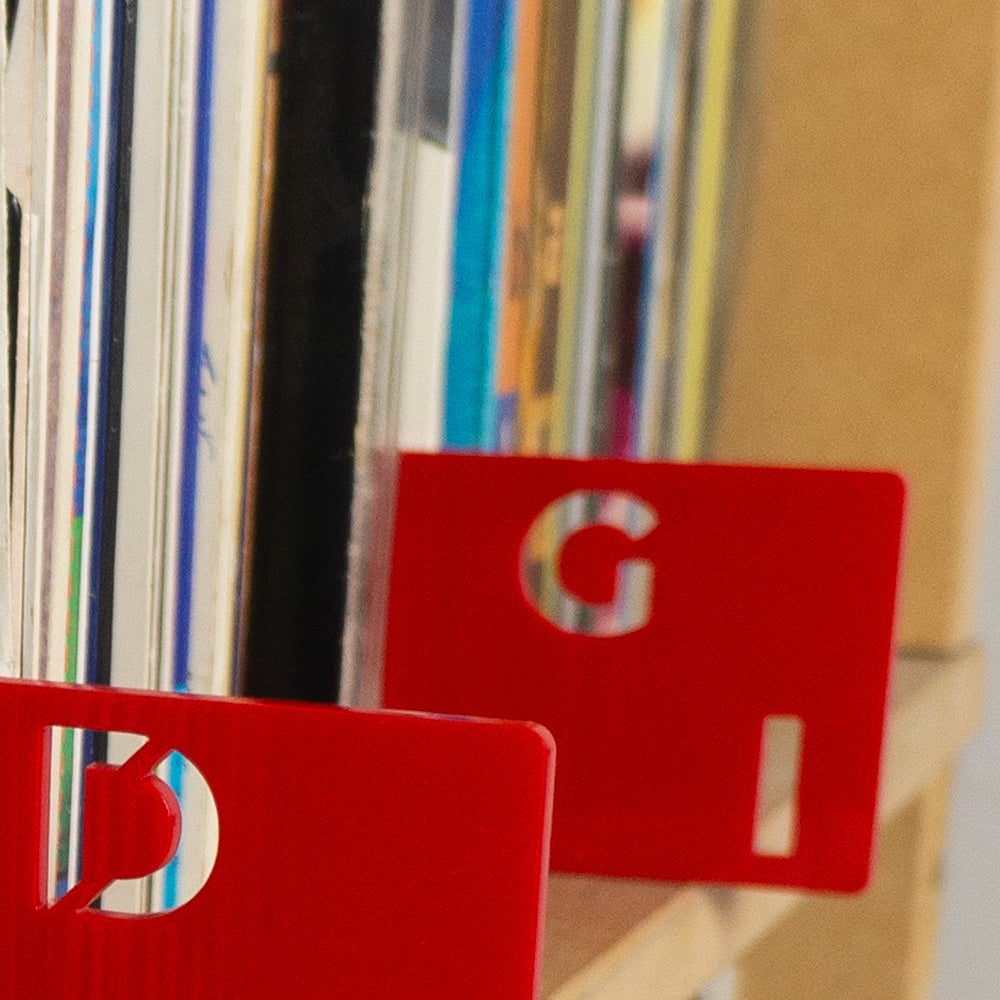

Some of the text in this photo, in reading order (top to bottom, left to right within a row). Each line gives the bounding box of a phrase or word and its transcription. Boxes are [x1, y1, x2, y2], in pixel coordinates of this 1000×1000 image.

[520, 489, 659, 637] G
[39, 725, 219, 919] D
[751, 714, 804, 858] I
